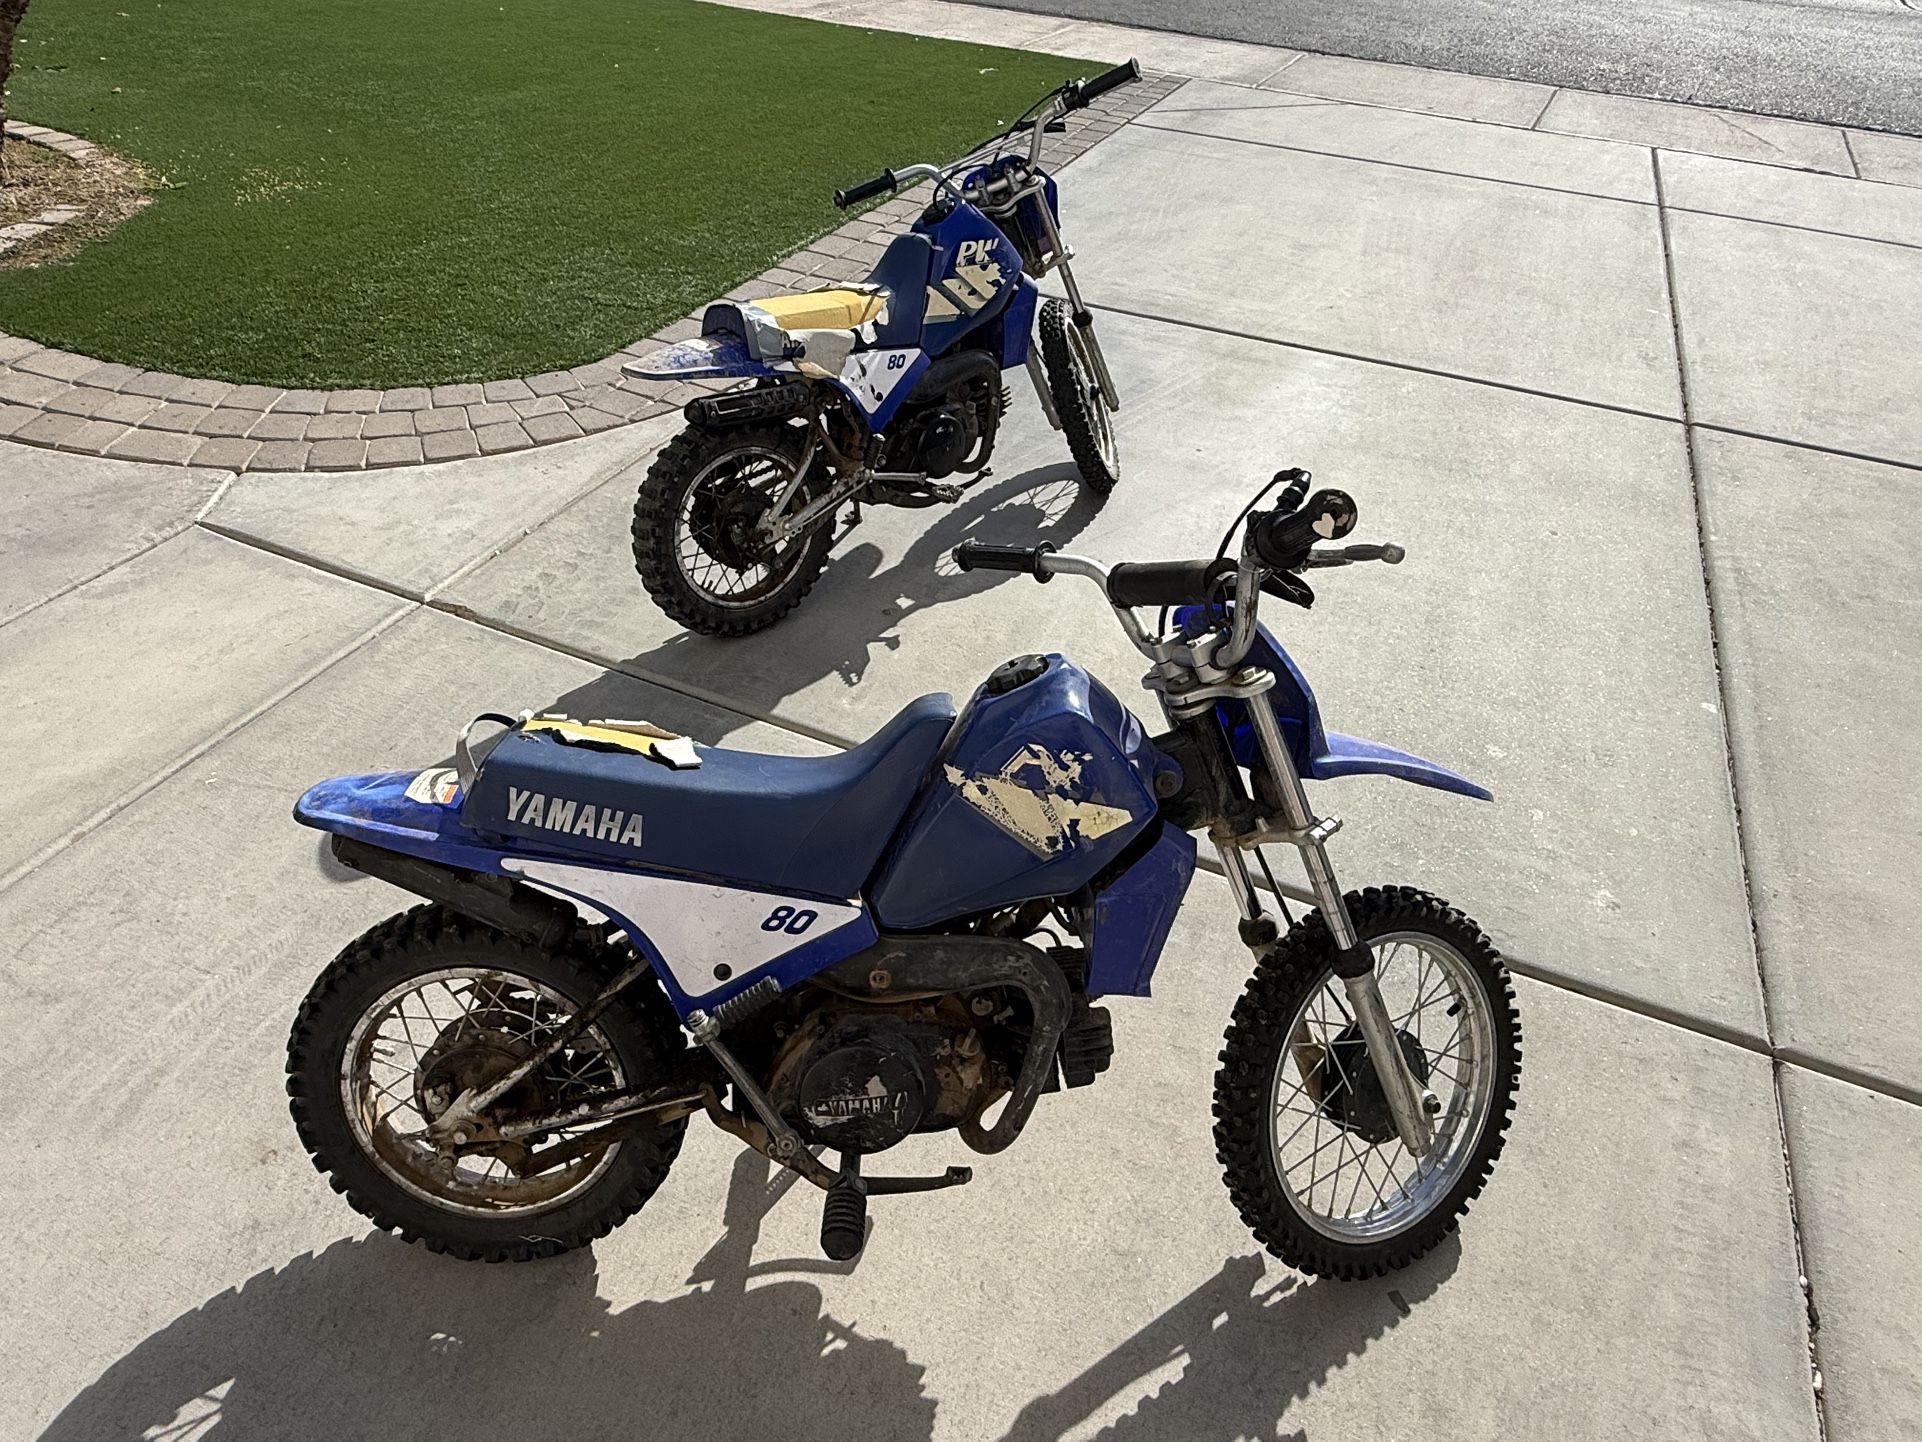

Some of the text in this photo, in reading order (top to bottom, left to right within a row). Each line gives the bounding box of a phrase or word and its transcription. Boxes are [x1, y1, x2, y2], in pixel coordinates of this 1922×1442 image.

[887, 354, 906, 370] 80
[507, 786, 643, 847] YAMAHA
[761, 905, 818, 935] 80
